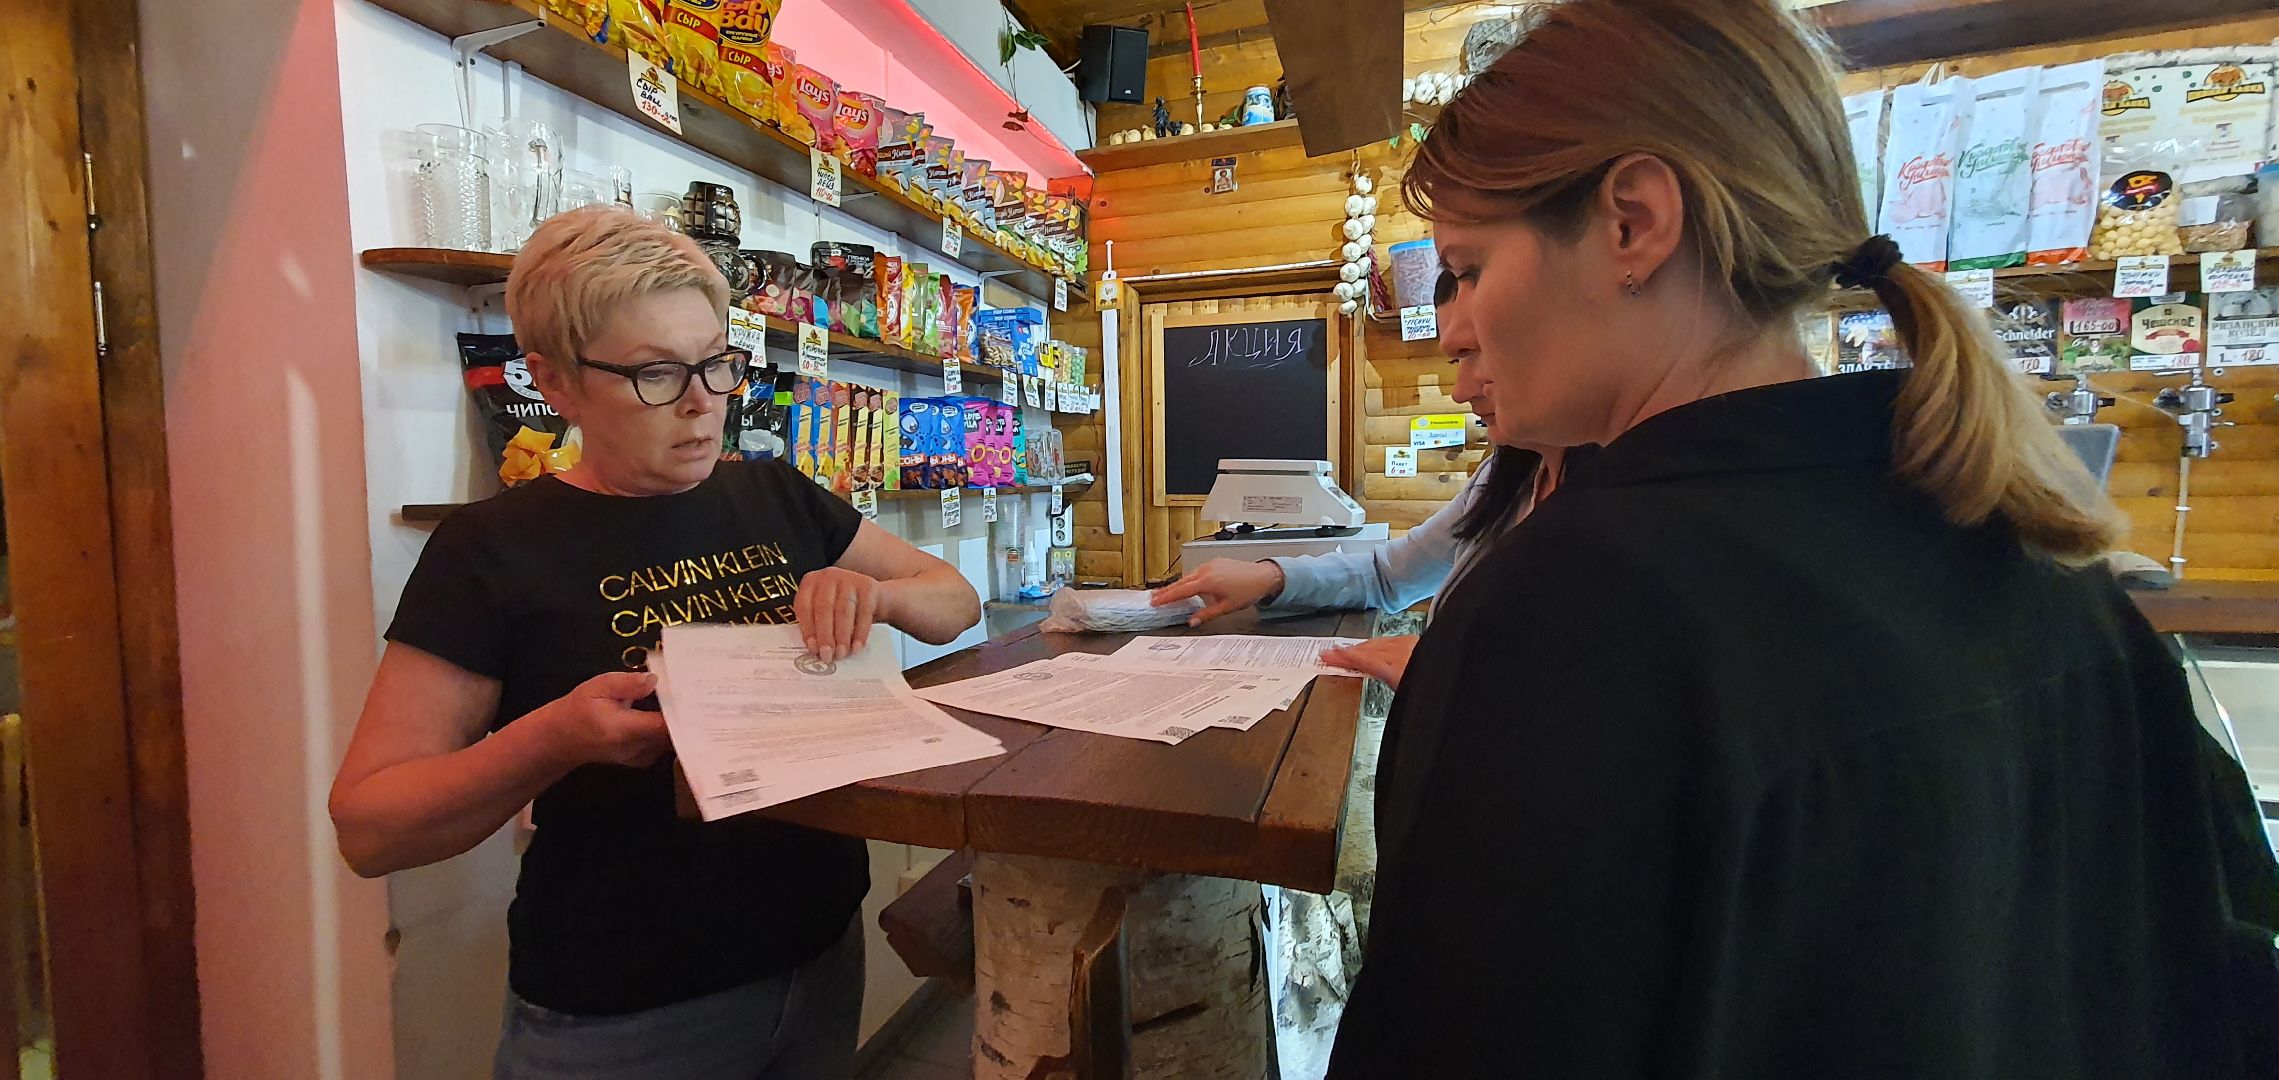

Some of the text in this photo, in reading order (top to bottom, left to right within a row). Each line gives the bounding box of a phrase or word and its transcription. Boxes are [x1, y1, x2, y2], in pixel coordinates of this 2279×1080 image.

[676, 12, 701, 28] СЫР
[728, 51, 751, 64] СЫР
[800, 78, 830, 102] Lay's
[2076, 319, 2115, 332] 165-00
[1188, 327, 1305, 367] АКЦИЯ
[599, 542, 788, 602] CALVIN KLEIN
[611, 572, 799, 637] CALVIN KLEIN
